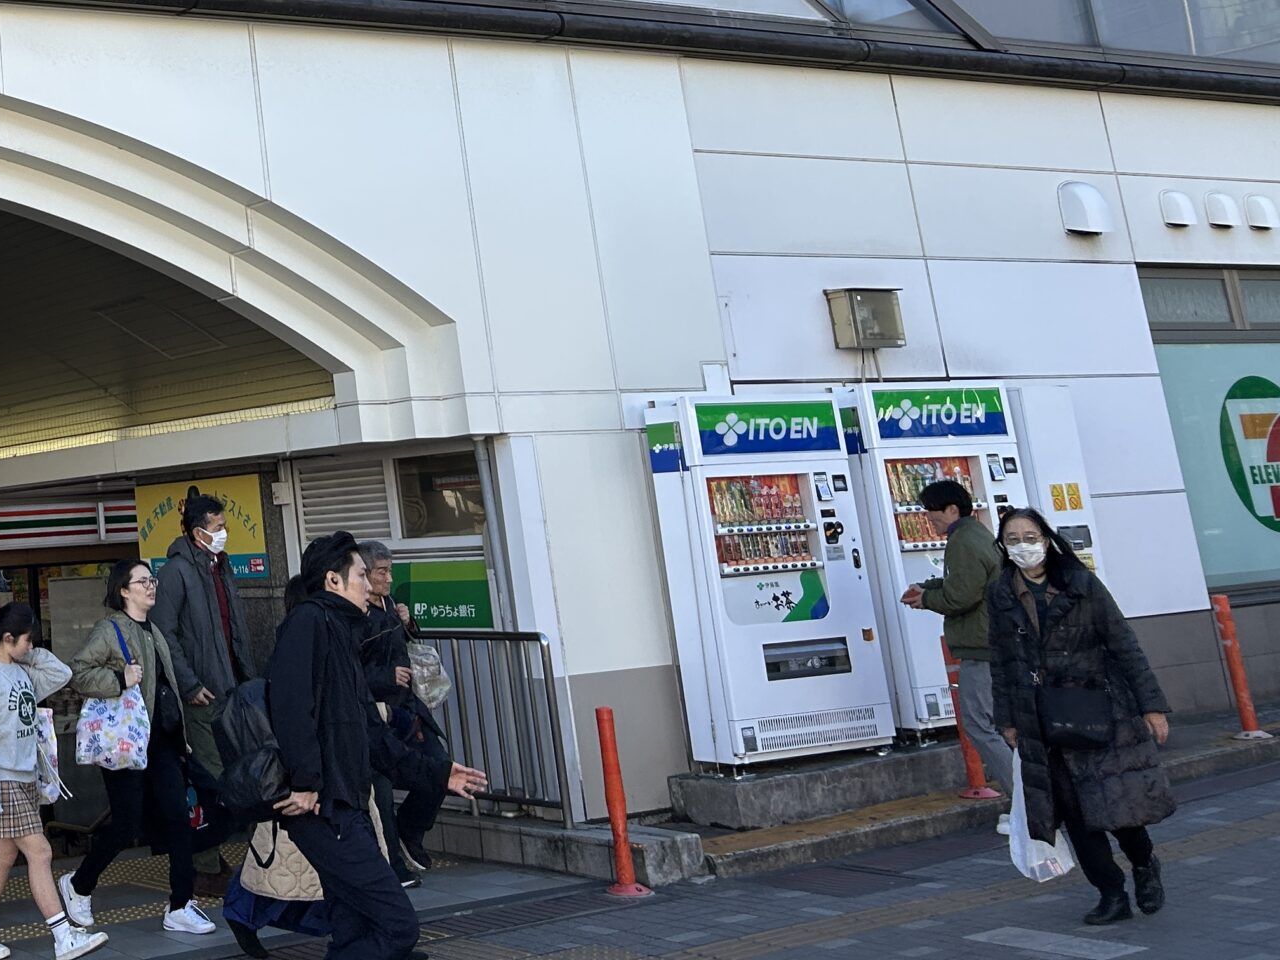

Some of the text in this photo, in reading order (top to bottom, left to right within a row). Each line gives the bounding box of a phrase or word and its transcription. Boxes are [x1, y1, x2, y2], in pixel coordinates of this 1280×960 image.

[922, 402, 986, 425] ITO EN
[748, 416, 818, 440] ITO EN
[430, 604, 476, 618] ゆうちょ銀行
